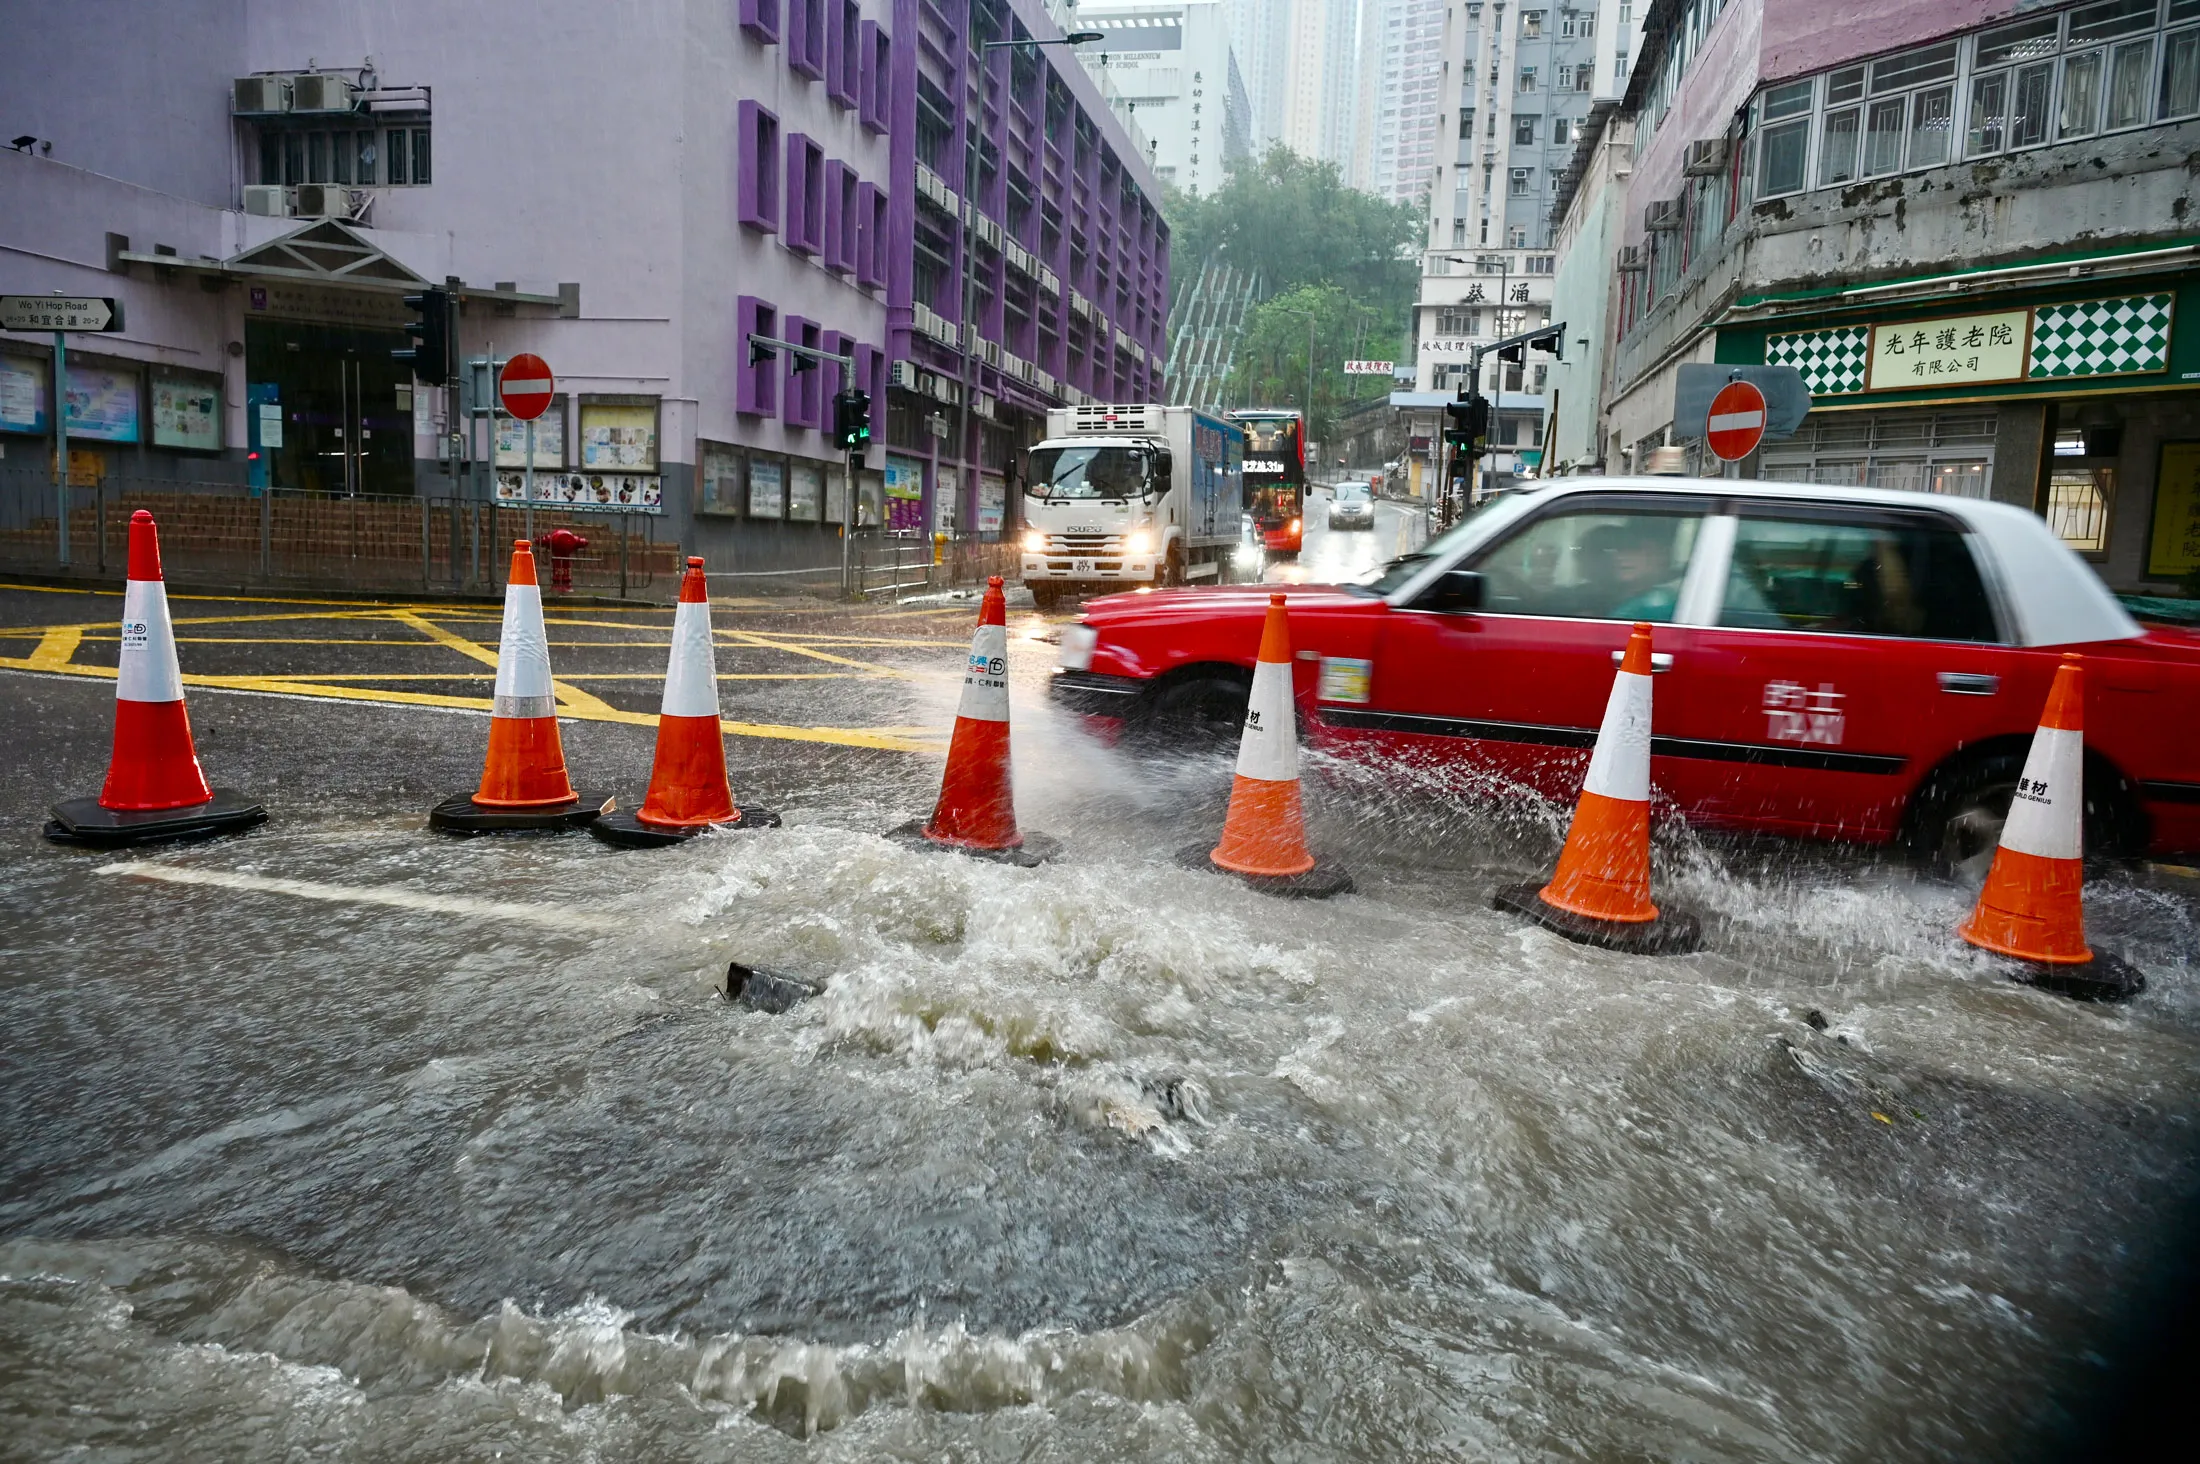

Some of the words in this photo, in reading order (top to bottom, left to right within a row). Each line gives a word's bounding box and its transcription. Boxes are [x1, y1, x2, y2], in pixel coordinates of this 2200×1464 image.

[1466, 282, 1529, 303] 葵涌
[19, 301, 32, 309] Wo
[35, 301, 44, 309] Yi
[46, 302, 62, 310] Hop
[65, 302, 88, 310] Road
[29, 314, 77, 326] 和宜合道
[1884, 323, 2013, 355] 光年護老院
[1911, 356, 1979, 376] 有限公司
[2028, 794, 2052, 805] GENIUS
